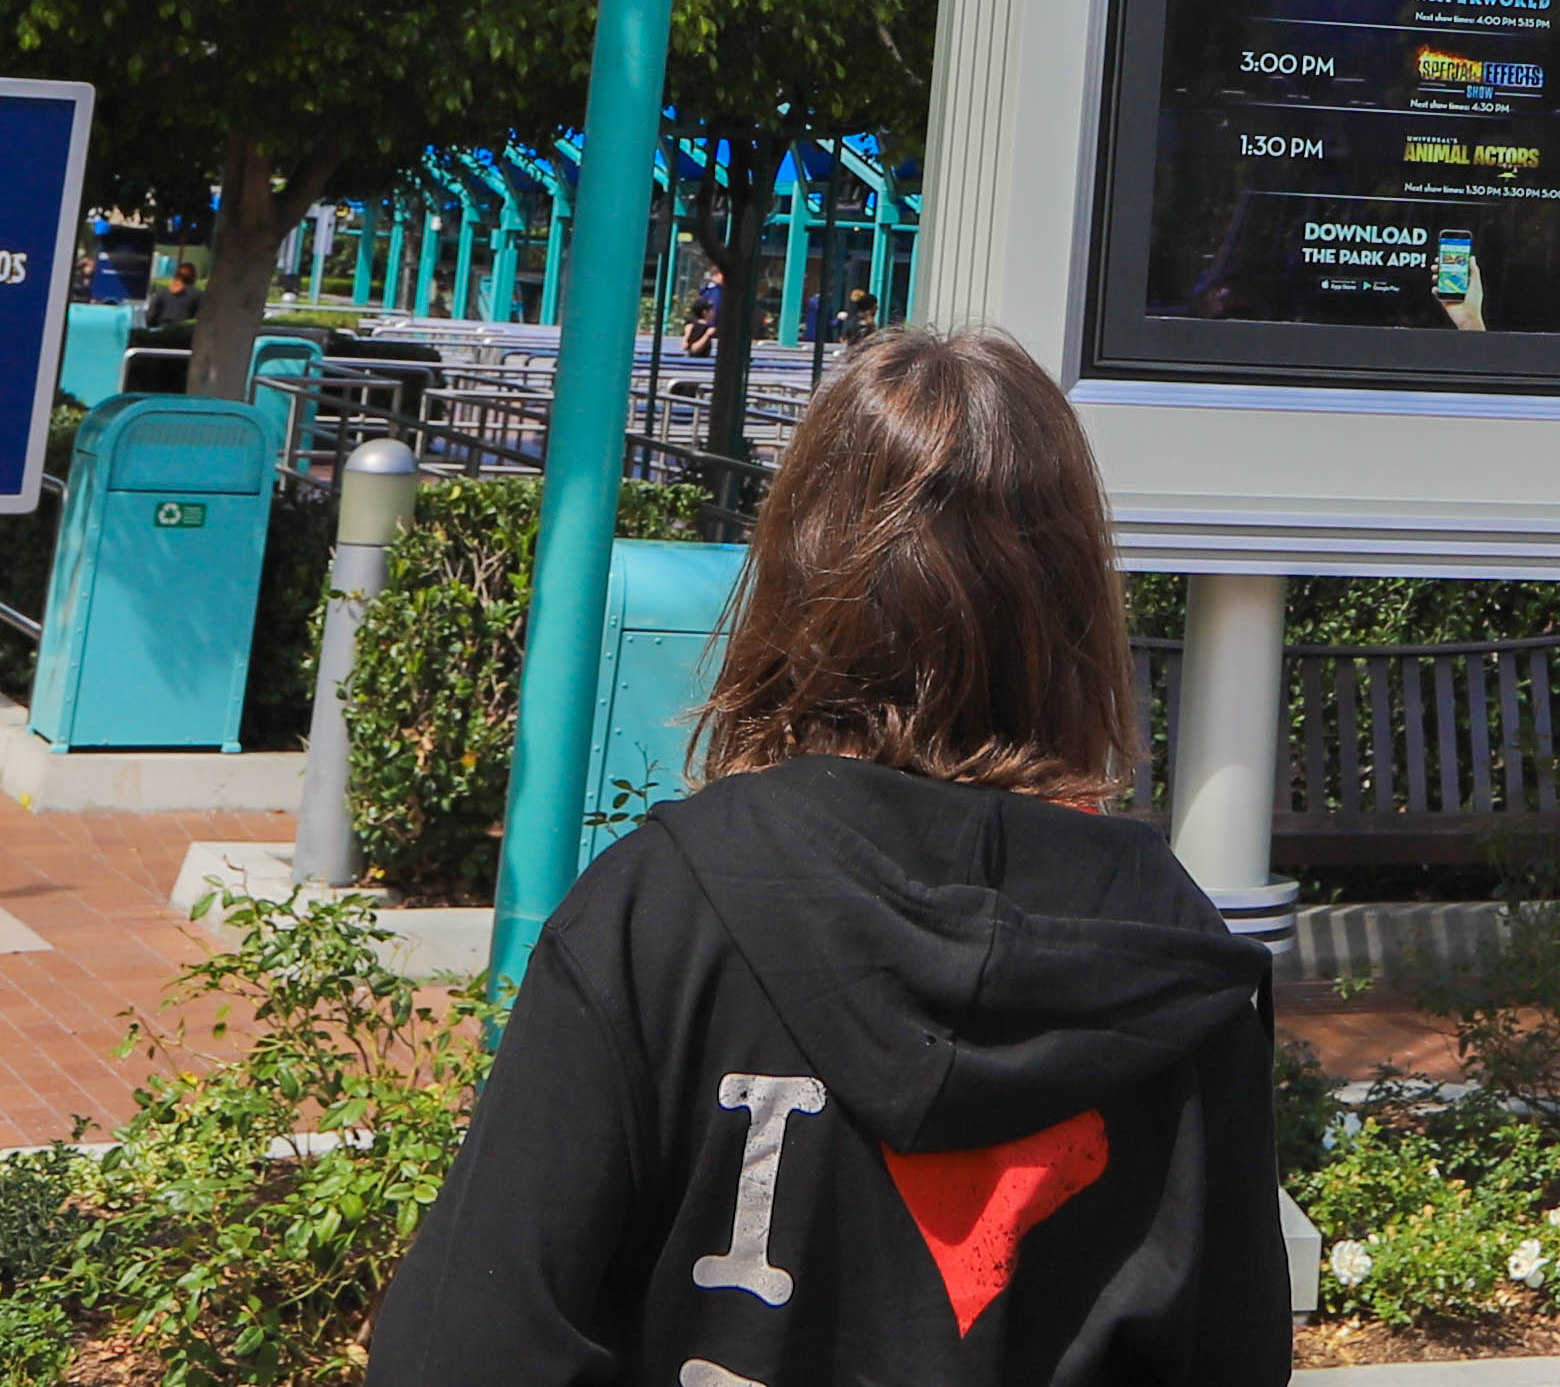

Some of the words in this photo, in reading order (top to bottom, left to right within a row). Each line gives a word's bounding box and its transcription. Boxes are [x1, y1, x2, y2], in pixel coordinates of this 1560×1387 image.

[1501, 16, 1517, 27] PM
[1536, 18, 1550, 28] PM
[1240, 52, 1298, 74] 3:00
[1302, 55, 1335, 77] PM
[1422, 59, 1478, 82] SPECIAL
[1485, 63, 1541, 86] EFFECTS
[1466, 85, 1495, 100] SHOW
[1494, 104, 1510, 114] PM
[1240, 134, 1286, 158] 1:30
[1290, 136, 1324, 160] PM
[1403, 142, 1471, 165] ANIMAL
[1473, 145, 1540, 169] ACTORS
[1486, 186, 1502, 196] PM
[1525, 188, 1540, 198] PM
[1304, 222, 1428, 246] DOWNLOAD
[1302, 247, 1336, 264] THE
[1339, 249, 1385, 266] PARK
[1386, 252, 1427, 268] APP!
[691, 1073, 828, 1308] I
